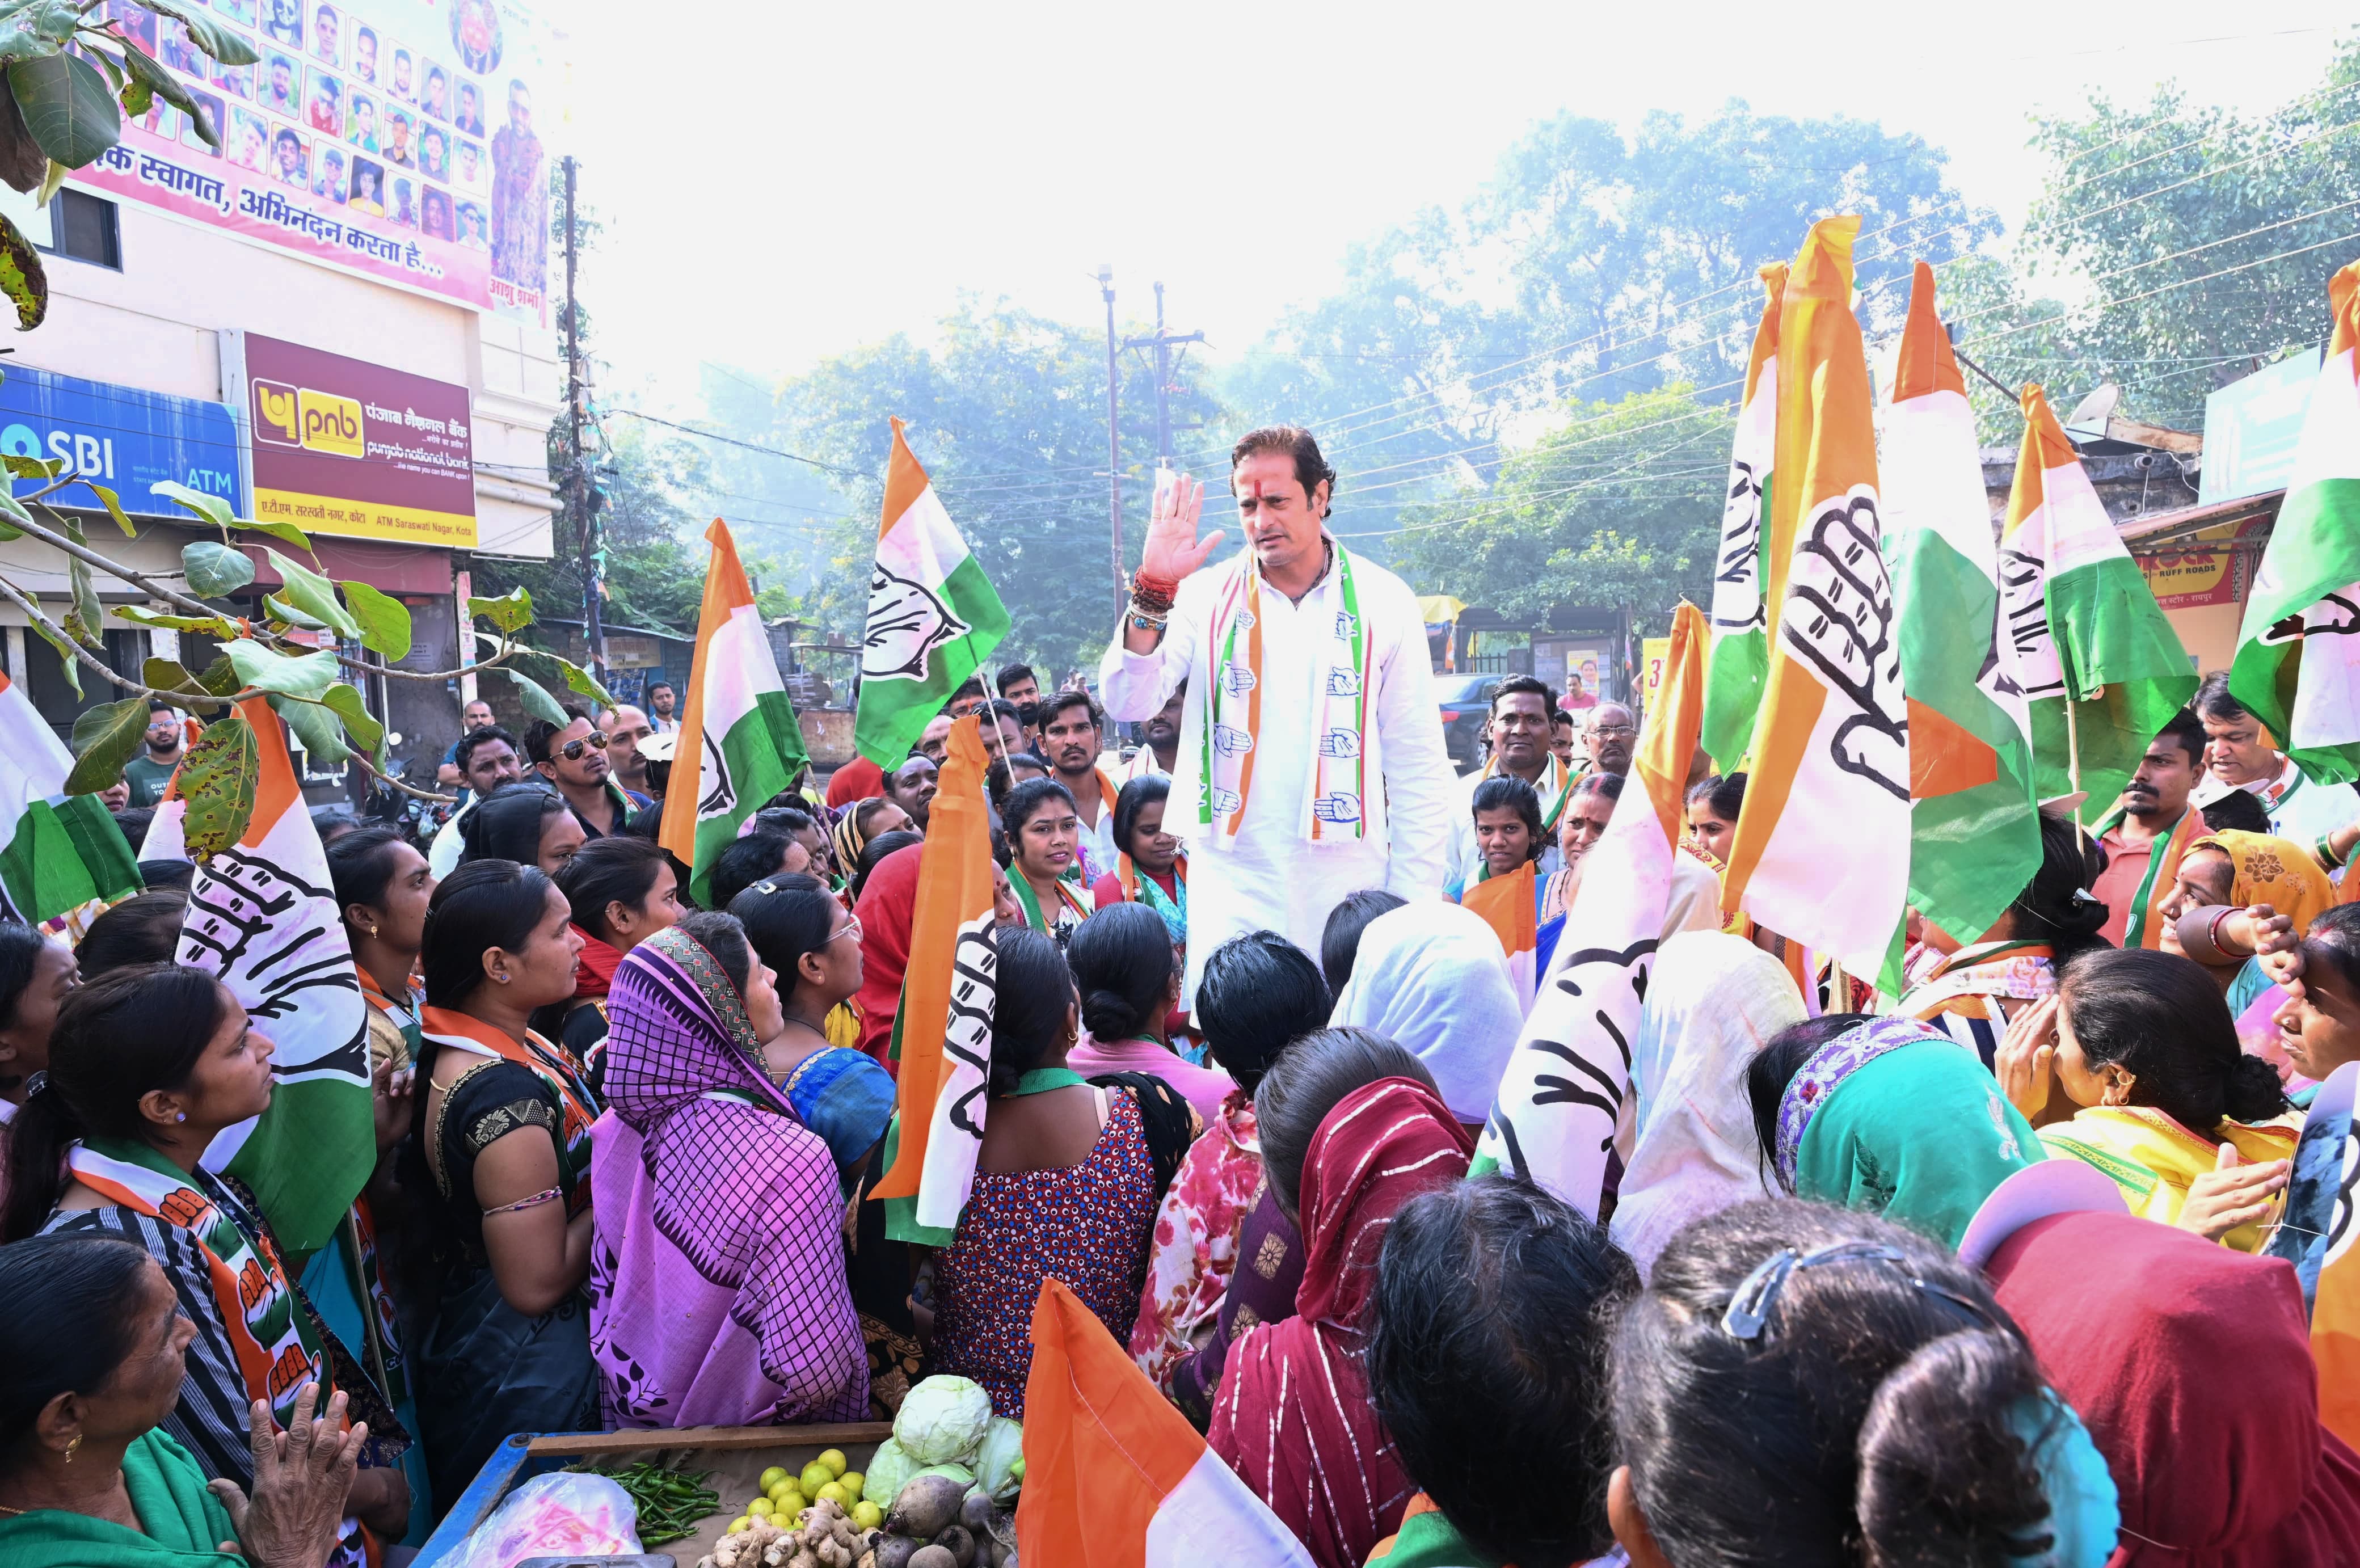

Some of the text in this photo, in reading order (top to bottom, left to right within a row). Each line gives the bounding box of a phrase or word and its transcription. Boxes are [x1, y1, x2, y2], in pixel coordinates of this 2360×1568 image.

[141, 154, 230, 212] स्वागत,
[240, 189, 342, 243] अभिनंदन
[347, 227, 401, 262] करता
[490, 279, 540, 309] आशु शर्मा
[305, 404, 357, 441] pnb
[365, 402, 467, 438] पंजाब नैशनल बैंक
[47, 430, 113, 479] SBI
[367, 441, 470, 470] punjab national bank
[187, 468, 232, 494] ATM
[295, 505, 325, 519] सरस्वती
[327, 509, 347, 524] नगर,
[349, 509, 366, 524] कोटा
[376, 516, 472, 536] ATM Saraswati Nagar, Kota
[2159, 568, 2182, 577] RUFF
[2186, 565, 2216, 574] ROADS
[2168, 595, 2184, 604] स्टोर
[2191, 593, 2212, 602] रायपुर
